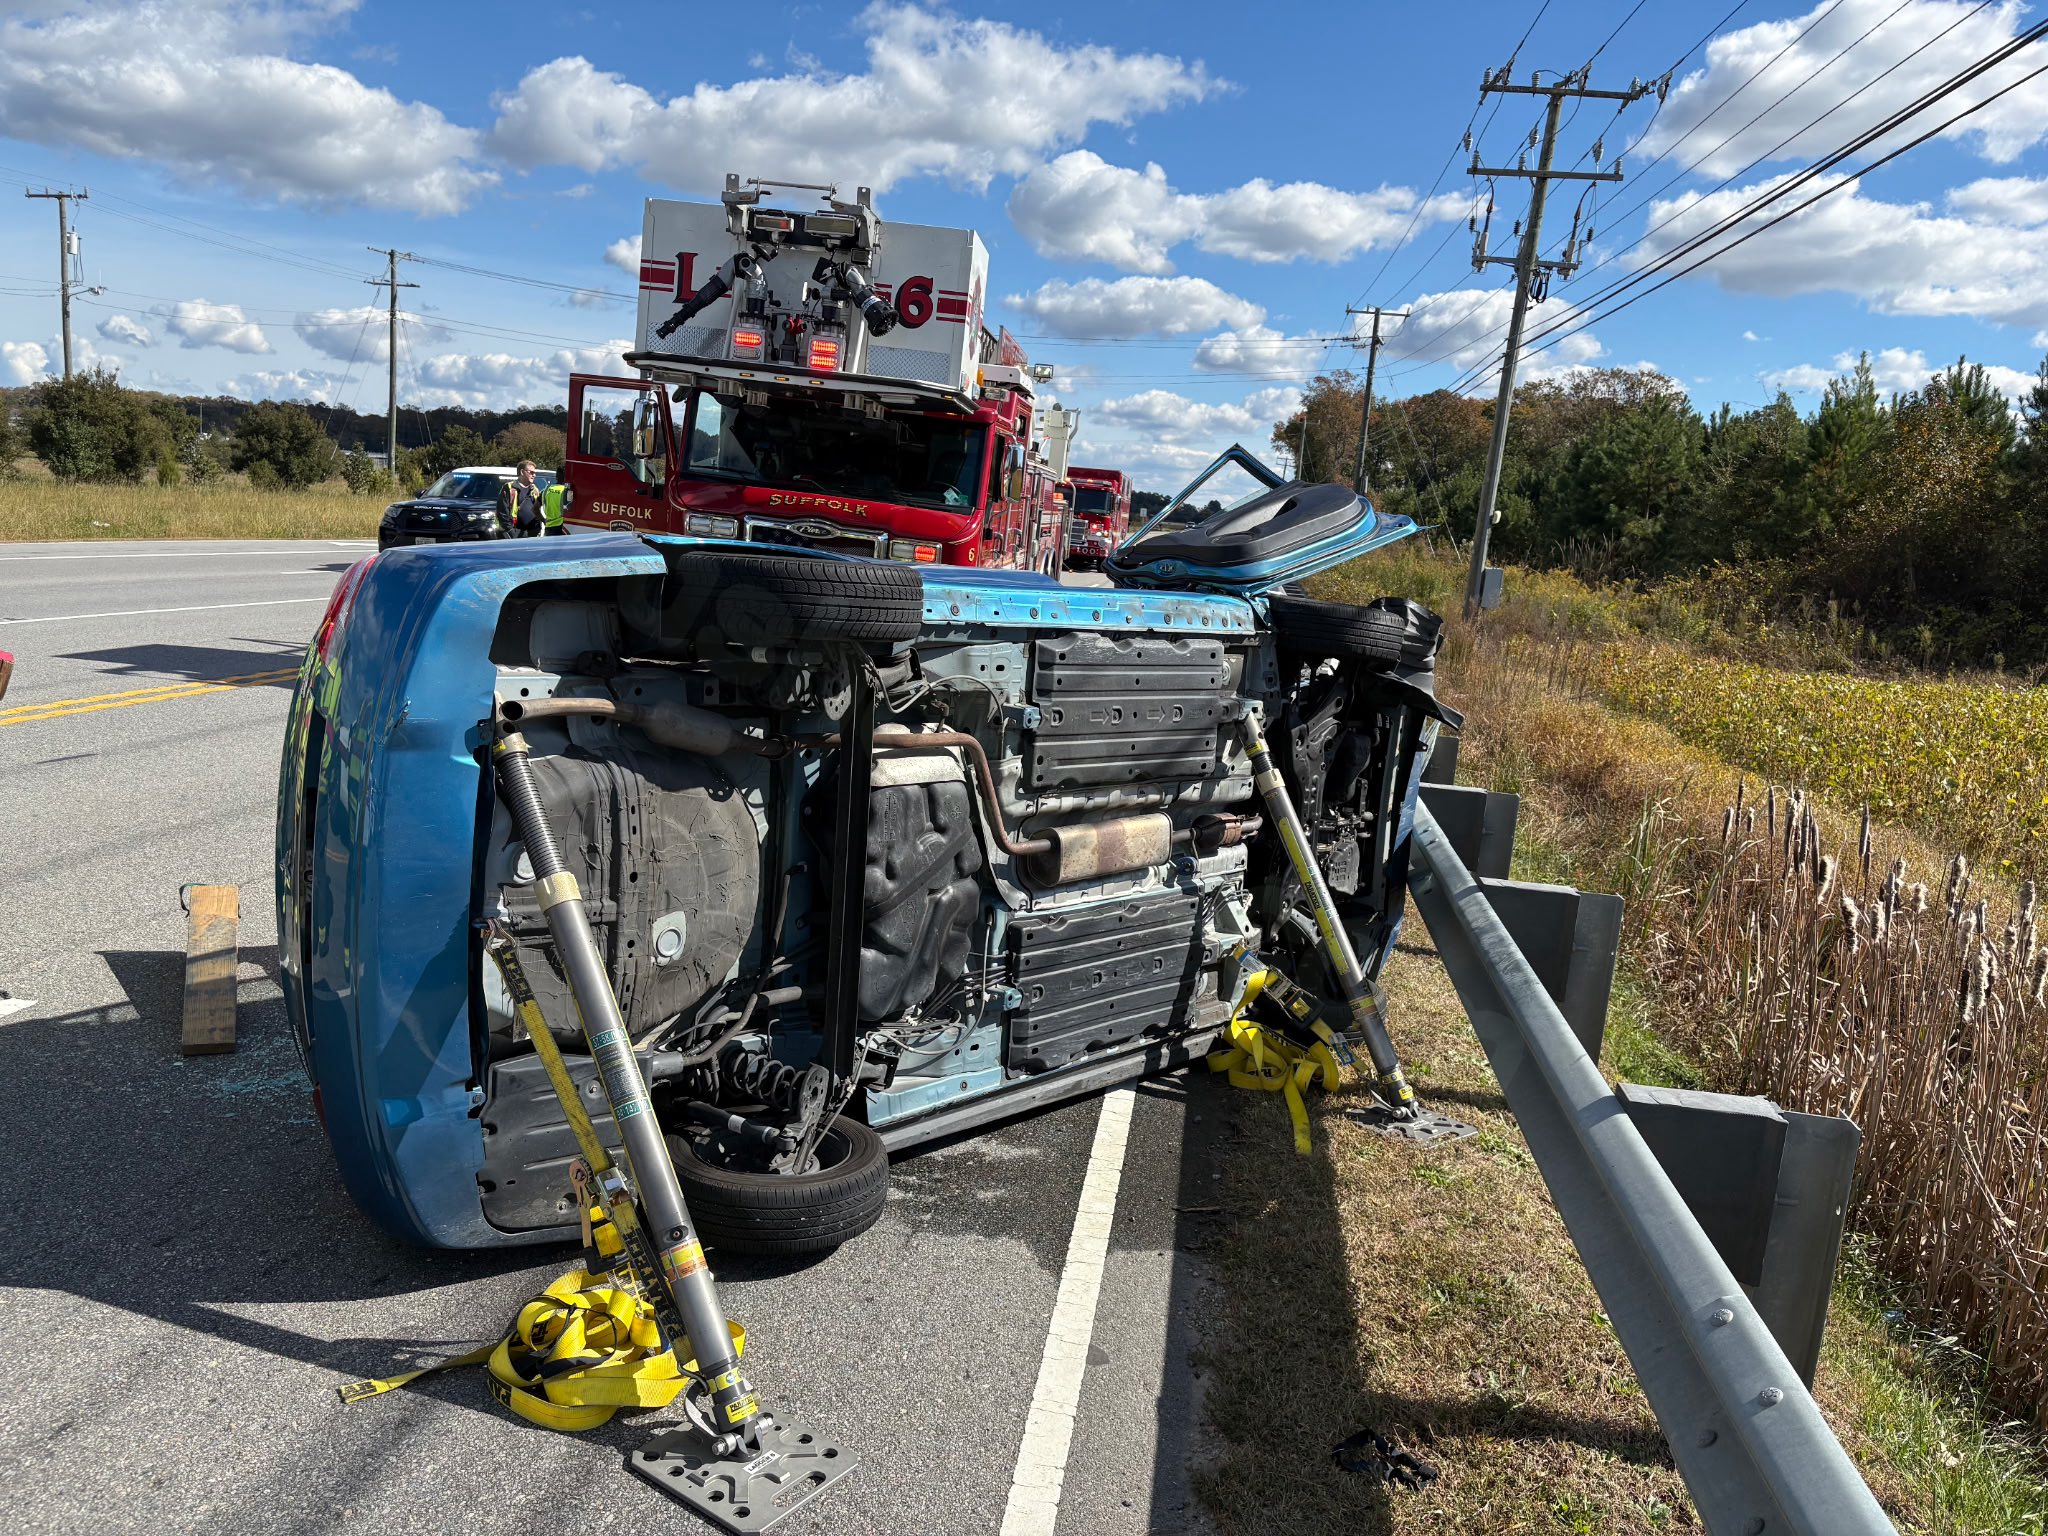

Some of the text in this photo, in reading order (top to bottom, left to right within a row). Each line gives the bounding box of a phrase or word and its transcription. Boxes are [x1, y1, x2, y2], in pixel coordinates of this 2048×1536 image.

[894, 275, 934, 329] 6
[592, 501, 653, 520] SUFFOLK
[769, 493, 869, 518] SUFFOLK
[968, 548, 976, 562] 6
